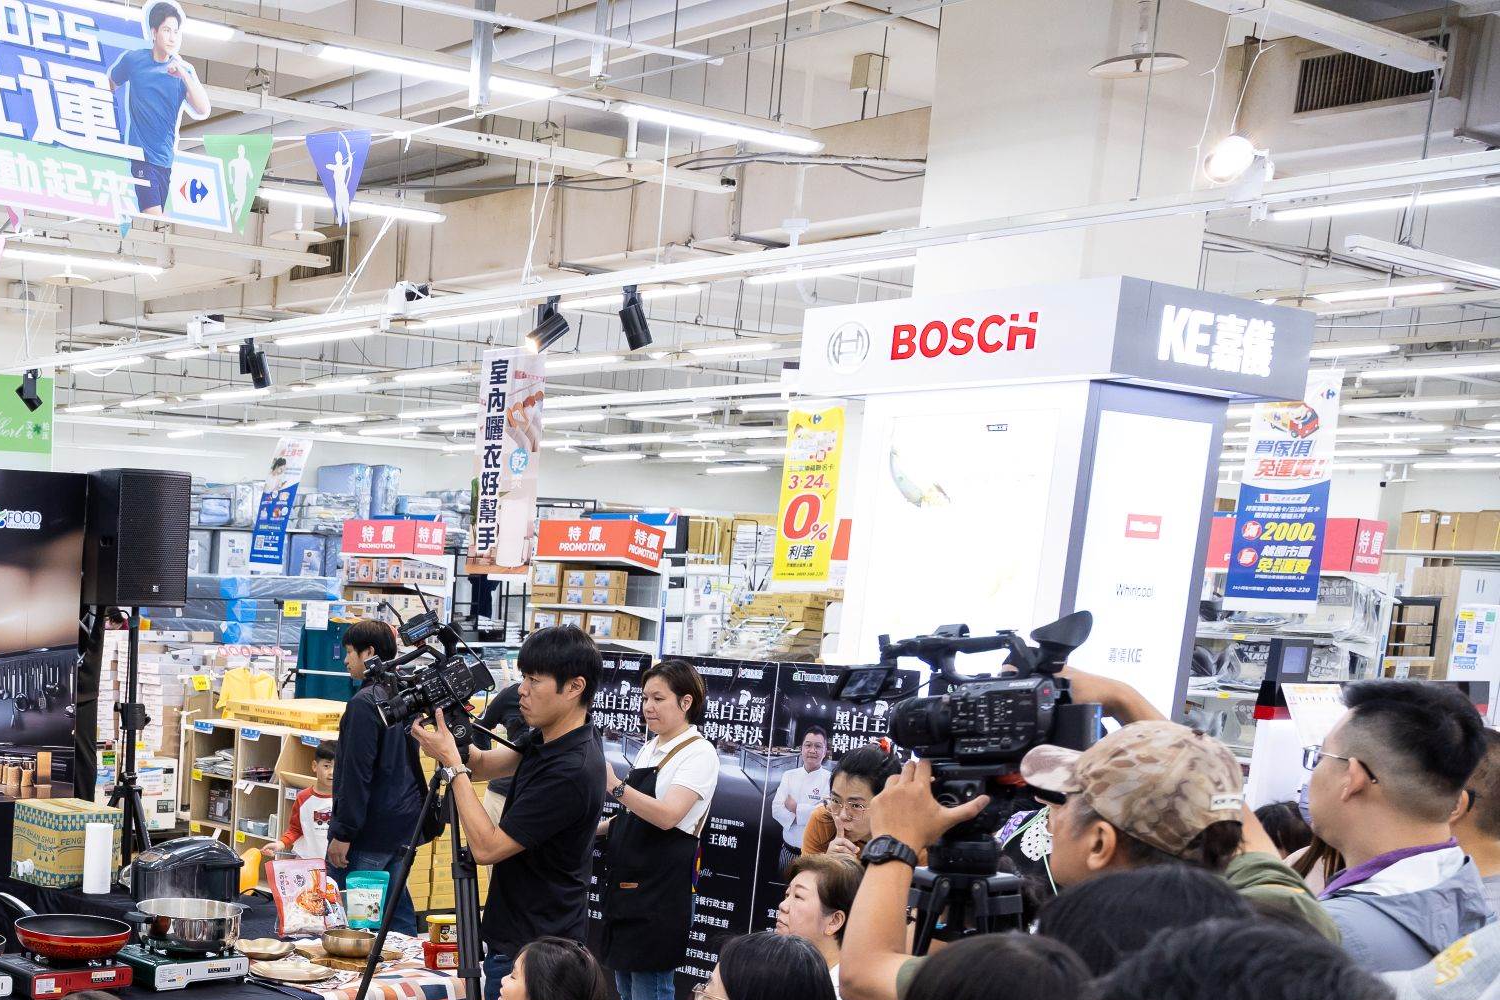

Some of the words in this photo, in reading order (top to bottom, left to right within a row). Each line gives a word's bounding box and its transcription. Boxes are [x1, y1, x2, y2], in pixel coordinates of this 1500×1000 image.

[891, 311, 1038, 360] BOSCH
[477, 359, 509, 551] 室內曬衣好幫手
[361, 525, 395, 543] 特價
[567, 526, 602, 541] 特價
[634, 528, 661, 550] 特價
[1358, 530, 1385, 555] 特價
[358, 542, 396, 550] PROMOTION
[559, 542, 606, 552] PROMOTION
[628, 544, 659, 561] PROMOTION
[788, 545, 815, 560] 利率
[592, 691, 643, 713] 黑白主廚
[751, 696, 766, 704] 2025
[592, 711, 641, 732] 韓味對決
[705, 700, 766, 724] 黑白主廚
[833, 710, 891, 734] 黑白主
[703, 721, 764, 746] 韓味對決
[688, 931, 707, 942] 主廚
